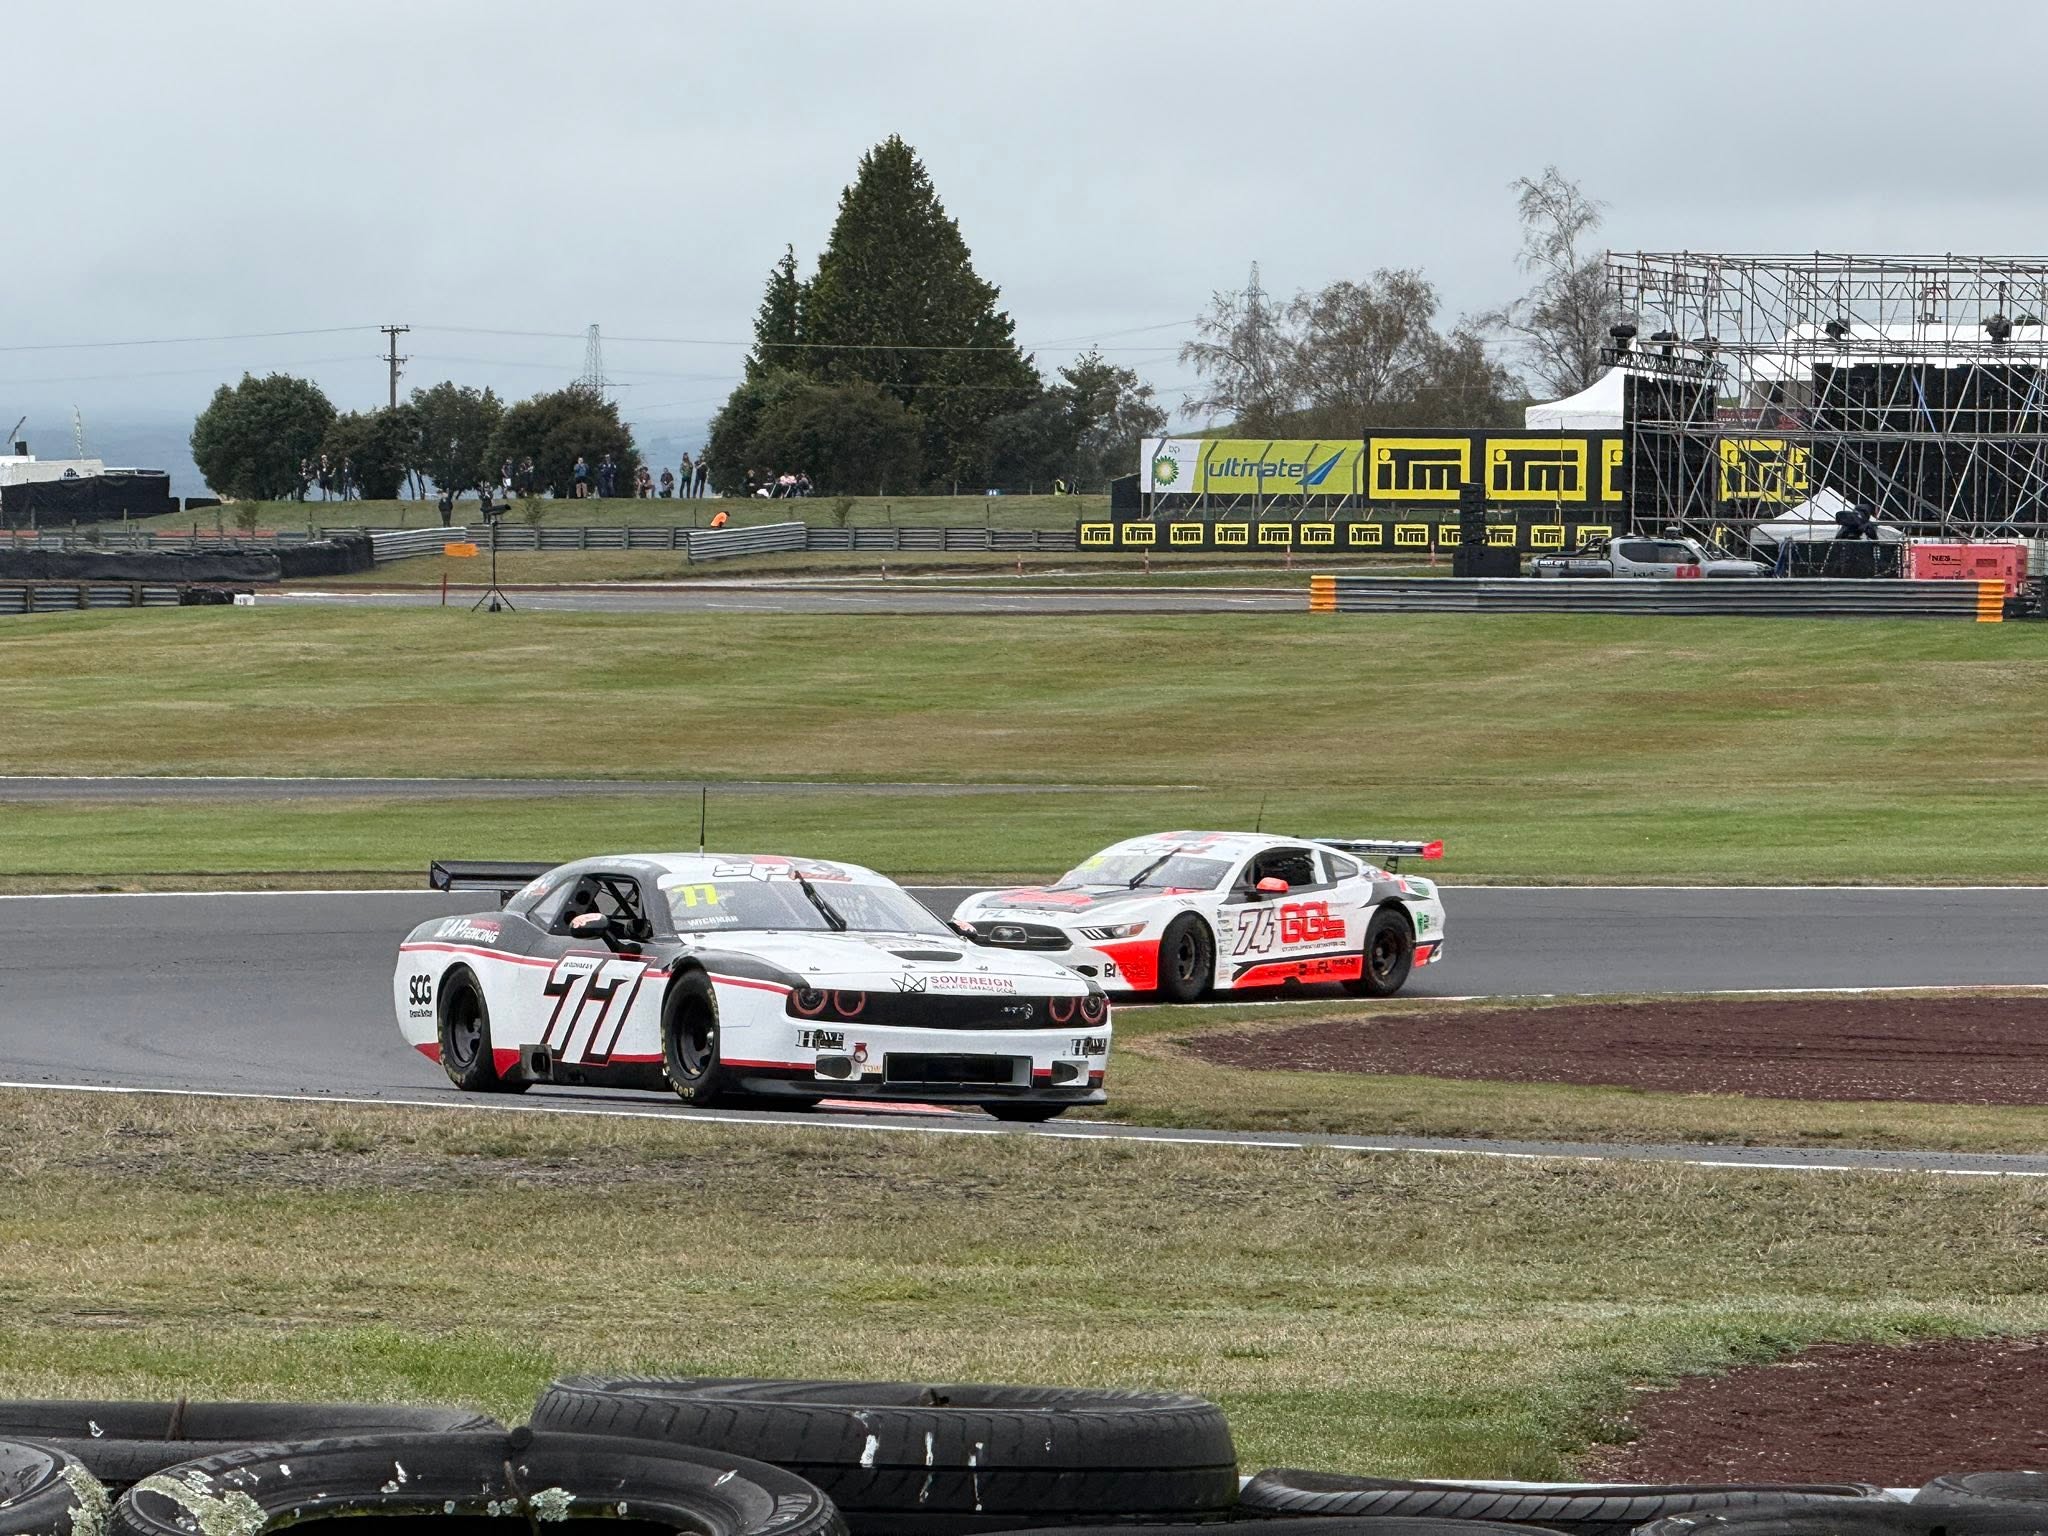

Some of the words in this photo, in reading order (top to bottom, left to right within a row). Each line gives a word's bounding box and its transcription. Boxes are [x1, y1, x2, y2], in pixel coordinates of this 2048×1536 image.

[1208, 457, 1304, 478] ultimate
[672, 883, 718, 907] 77
[409, 974, 432, 1006] SCG
[930, 975, 1014, 988] SOVEREIGN
[543, 952, 653, 1065] 77
